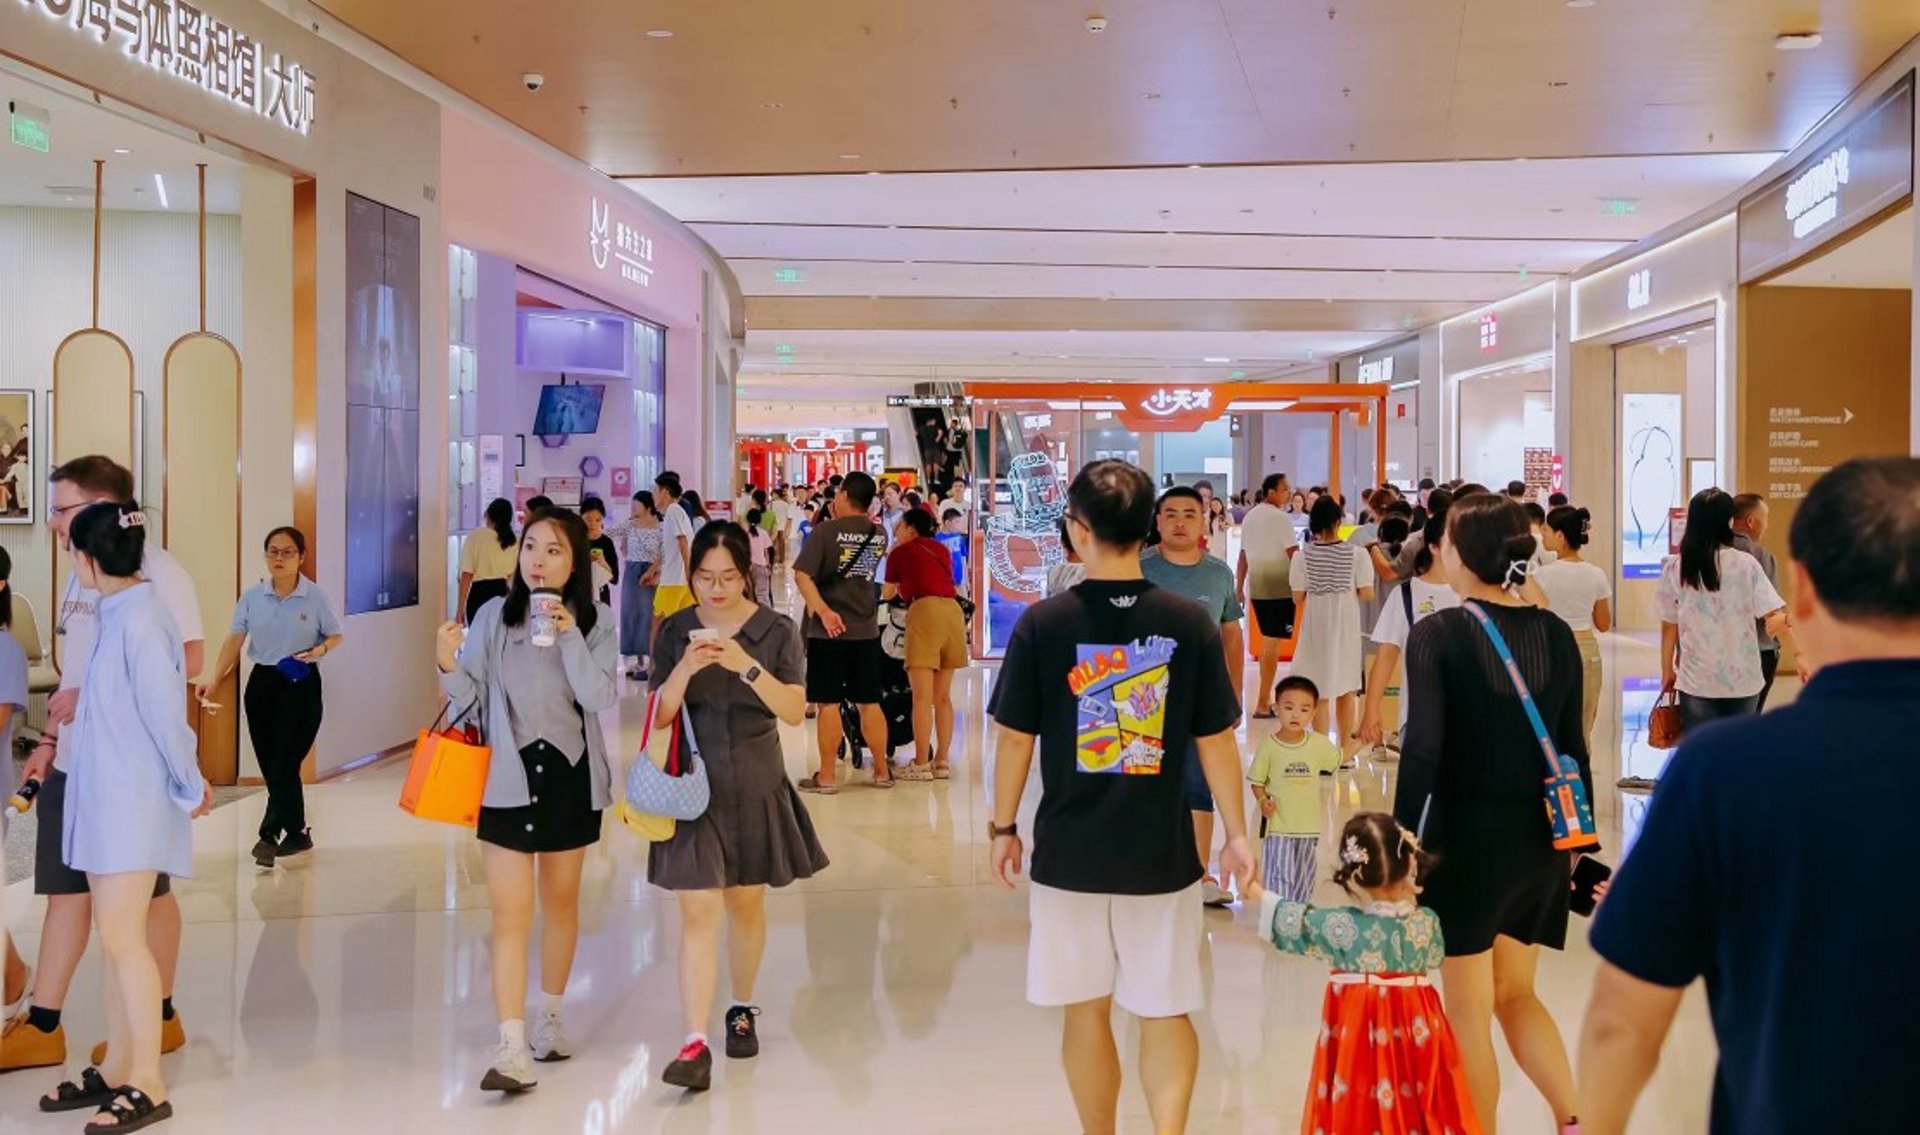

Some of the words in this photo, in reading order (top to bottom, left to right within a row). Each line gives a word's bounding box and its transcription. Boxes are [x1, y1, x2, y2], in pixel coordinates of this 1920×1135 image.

[266, 53, 316, 136] 大师
[1141, 388, 1212, 415] 小天才
